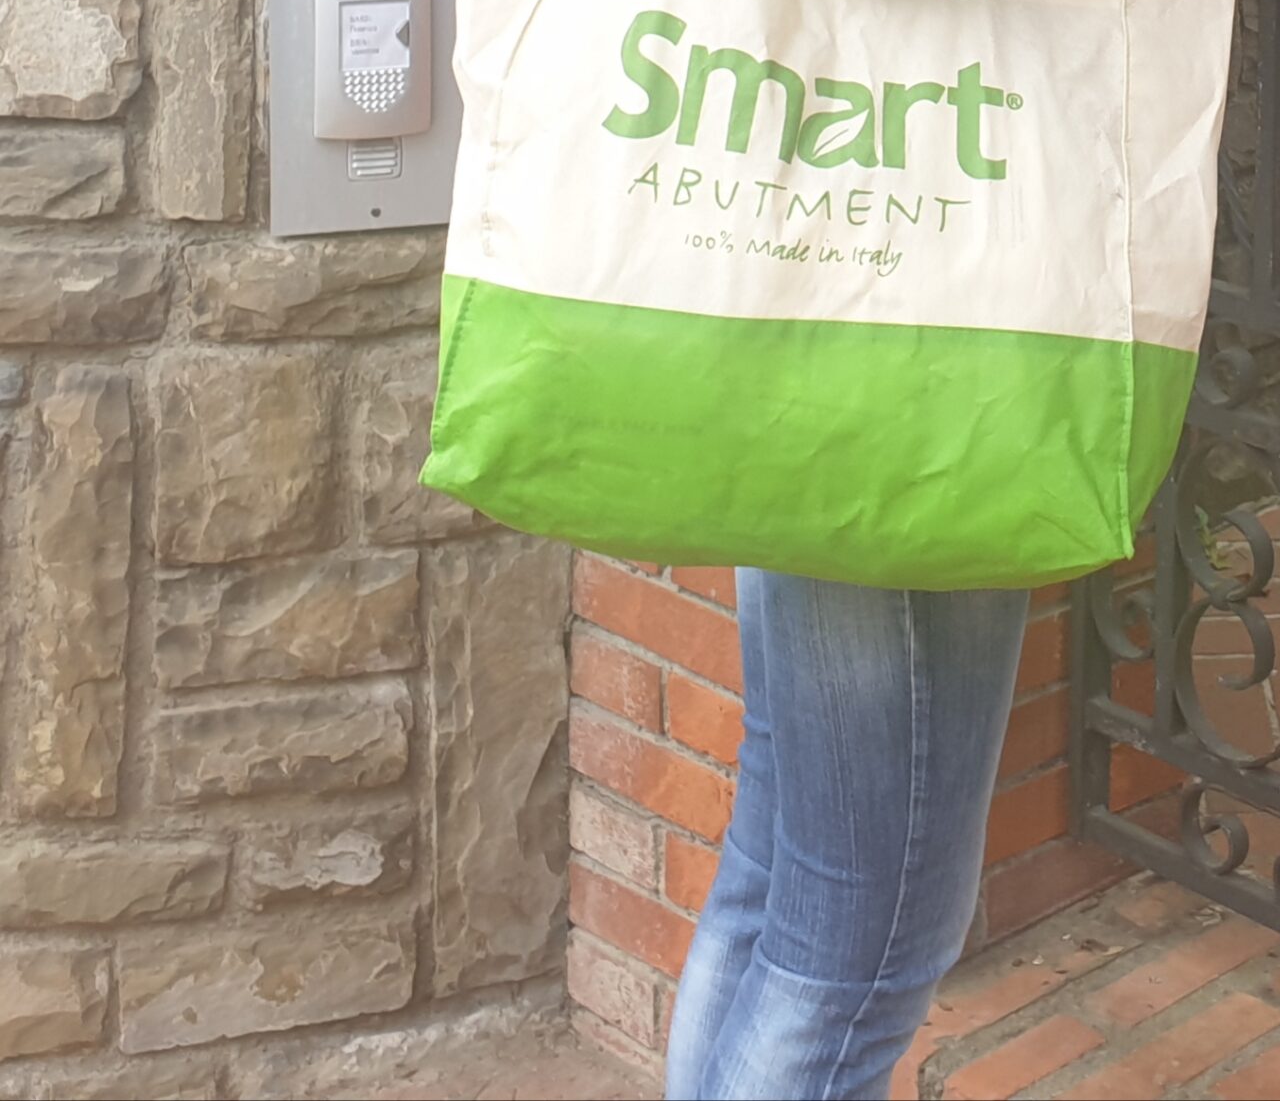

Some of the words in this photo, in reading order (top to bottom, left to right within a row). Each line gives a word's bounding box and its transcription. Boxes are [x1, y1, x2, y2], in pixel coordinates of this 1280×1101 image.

[627, 162, 971, 233] ABUTMENT
[684, 230, 734, 254] 100%
[745, 237, 811, 264] Made
[817, 238, 845, 264] in
[851, 239, 903, 277] Italy
